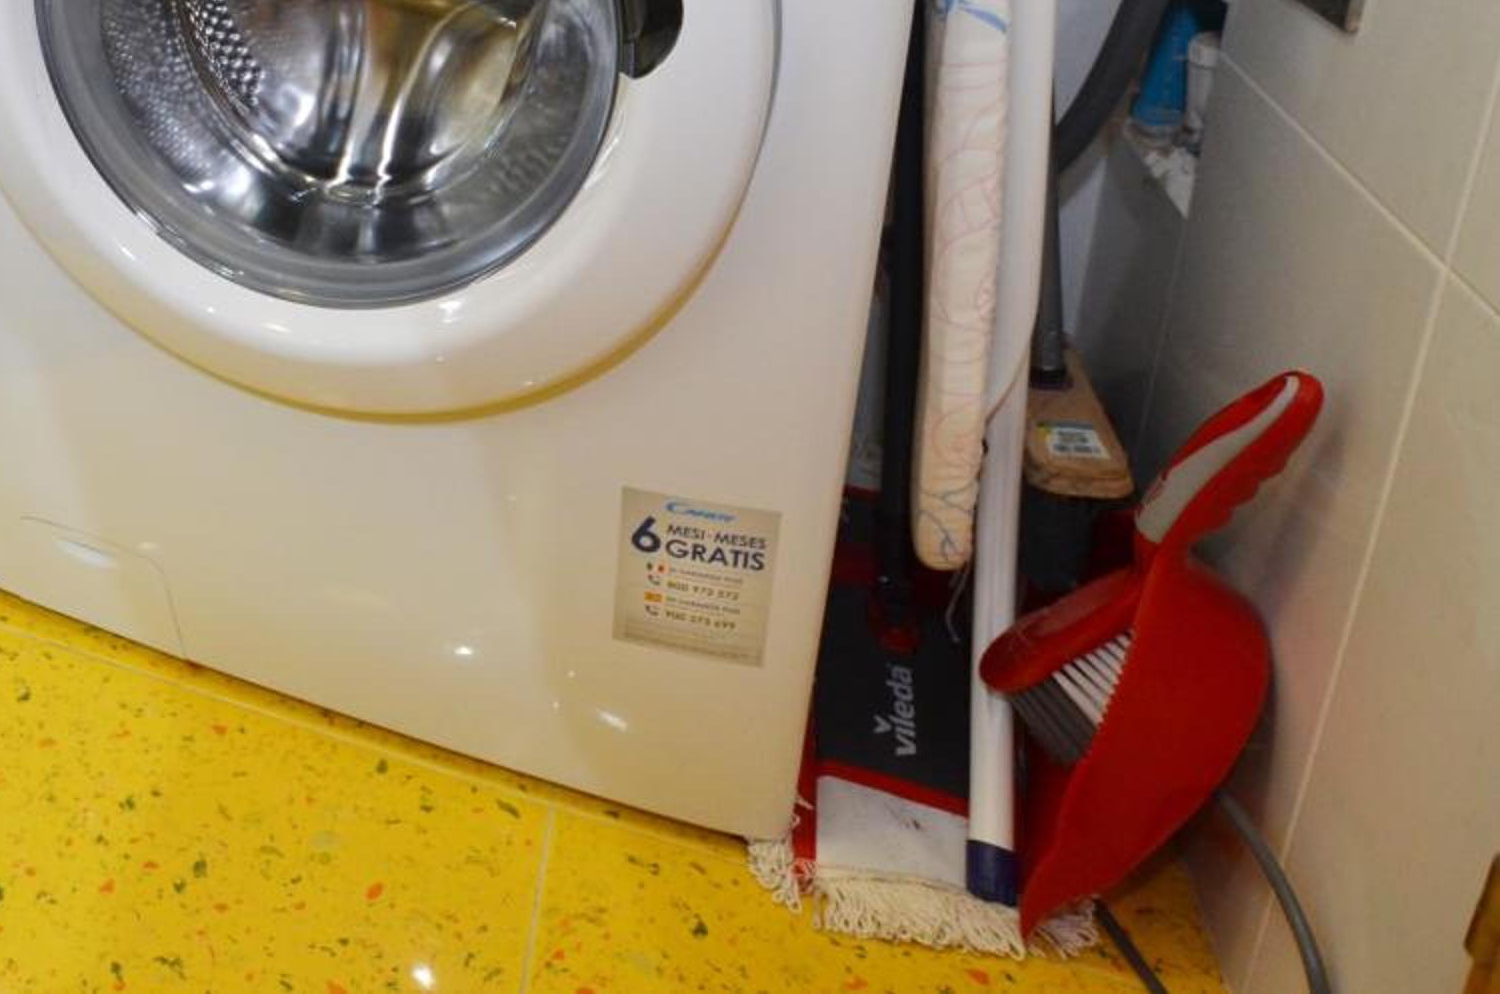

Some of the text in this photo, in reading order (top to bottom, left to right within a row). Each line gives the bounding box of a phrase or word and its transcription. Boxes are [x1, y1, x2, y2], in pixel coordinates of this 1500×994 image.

[631, 515, 661, 553] 6
[665, 538, 766, 572] GRATIS
[884, 664, 916, 757] vileda
